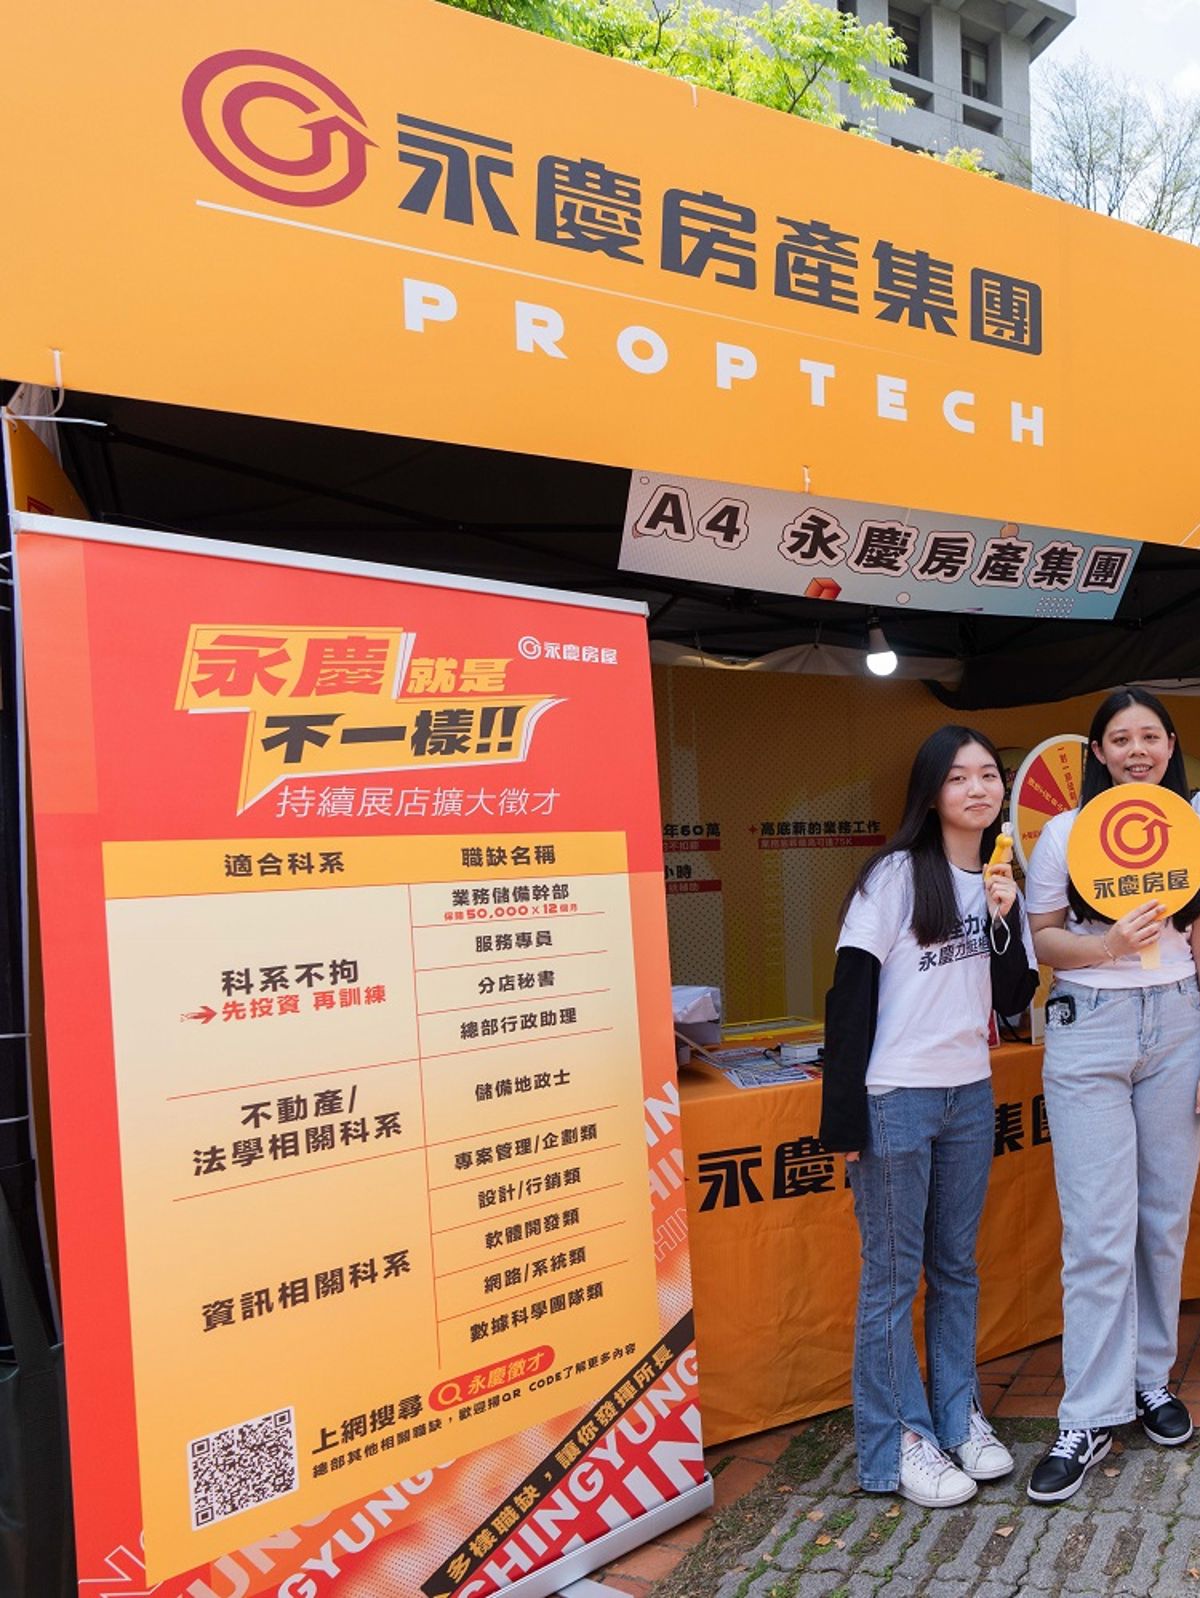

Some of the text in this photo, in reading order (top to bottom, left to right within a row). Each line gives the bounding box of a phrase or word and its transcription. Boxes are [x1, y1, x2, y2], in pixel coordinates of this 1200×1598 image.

[397, 112, 1042, 356] 永慶房產集團
[403, 277, 1044, 447] PROPTECH
[646, 485, 1126, 594] A4 永慶房產集團
[543, 641, 618, 666] 永慶房屋
[261, 704, 528, 764] 不一樣!!
[275, 786, 561, 819] 持續展店擴大徵才
[224, 851, 345, 878] 適合科系
[460, 844, 557, 867] 職缺名稱
[451, 883, 569, 907] 業務儲備幹部
[1093, 868, 1191, 899] 永慶房屋
[475, 930, 553, 953] 服務專員
[221, 959, 359, 997] 科系不拘
[478, 970, 555, 995] 分店秘書
[221, 985, 388, 1022] 先投資 再訓練
[460, 1007, 578, 1041] 總部行政助理
[474, 1068, 572, 1104] 儲備地政士
[240, 1085, 359, 1131] 不動產/
[192, 1111, 403, 1178] 法學相關科系
[453, 1122, 599, 1172] 專案管理/企劃類
[477, 1166, 582, 1210] 設計/行銷類
[484, 1207, 581, 1250] 軟體開發類
[202, 1248, 413, 1333] 資訊相關科系
[484, 1246, 587, 1295] 網路/系統類
[469, 1280, 605, 1344] 數據科學團隊類
[311, 1351, 546, 1456] 上網搜尋 永慶徵才
